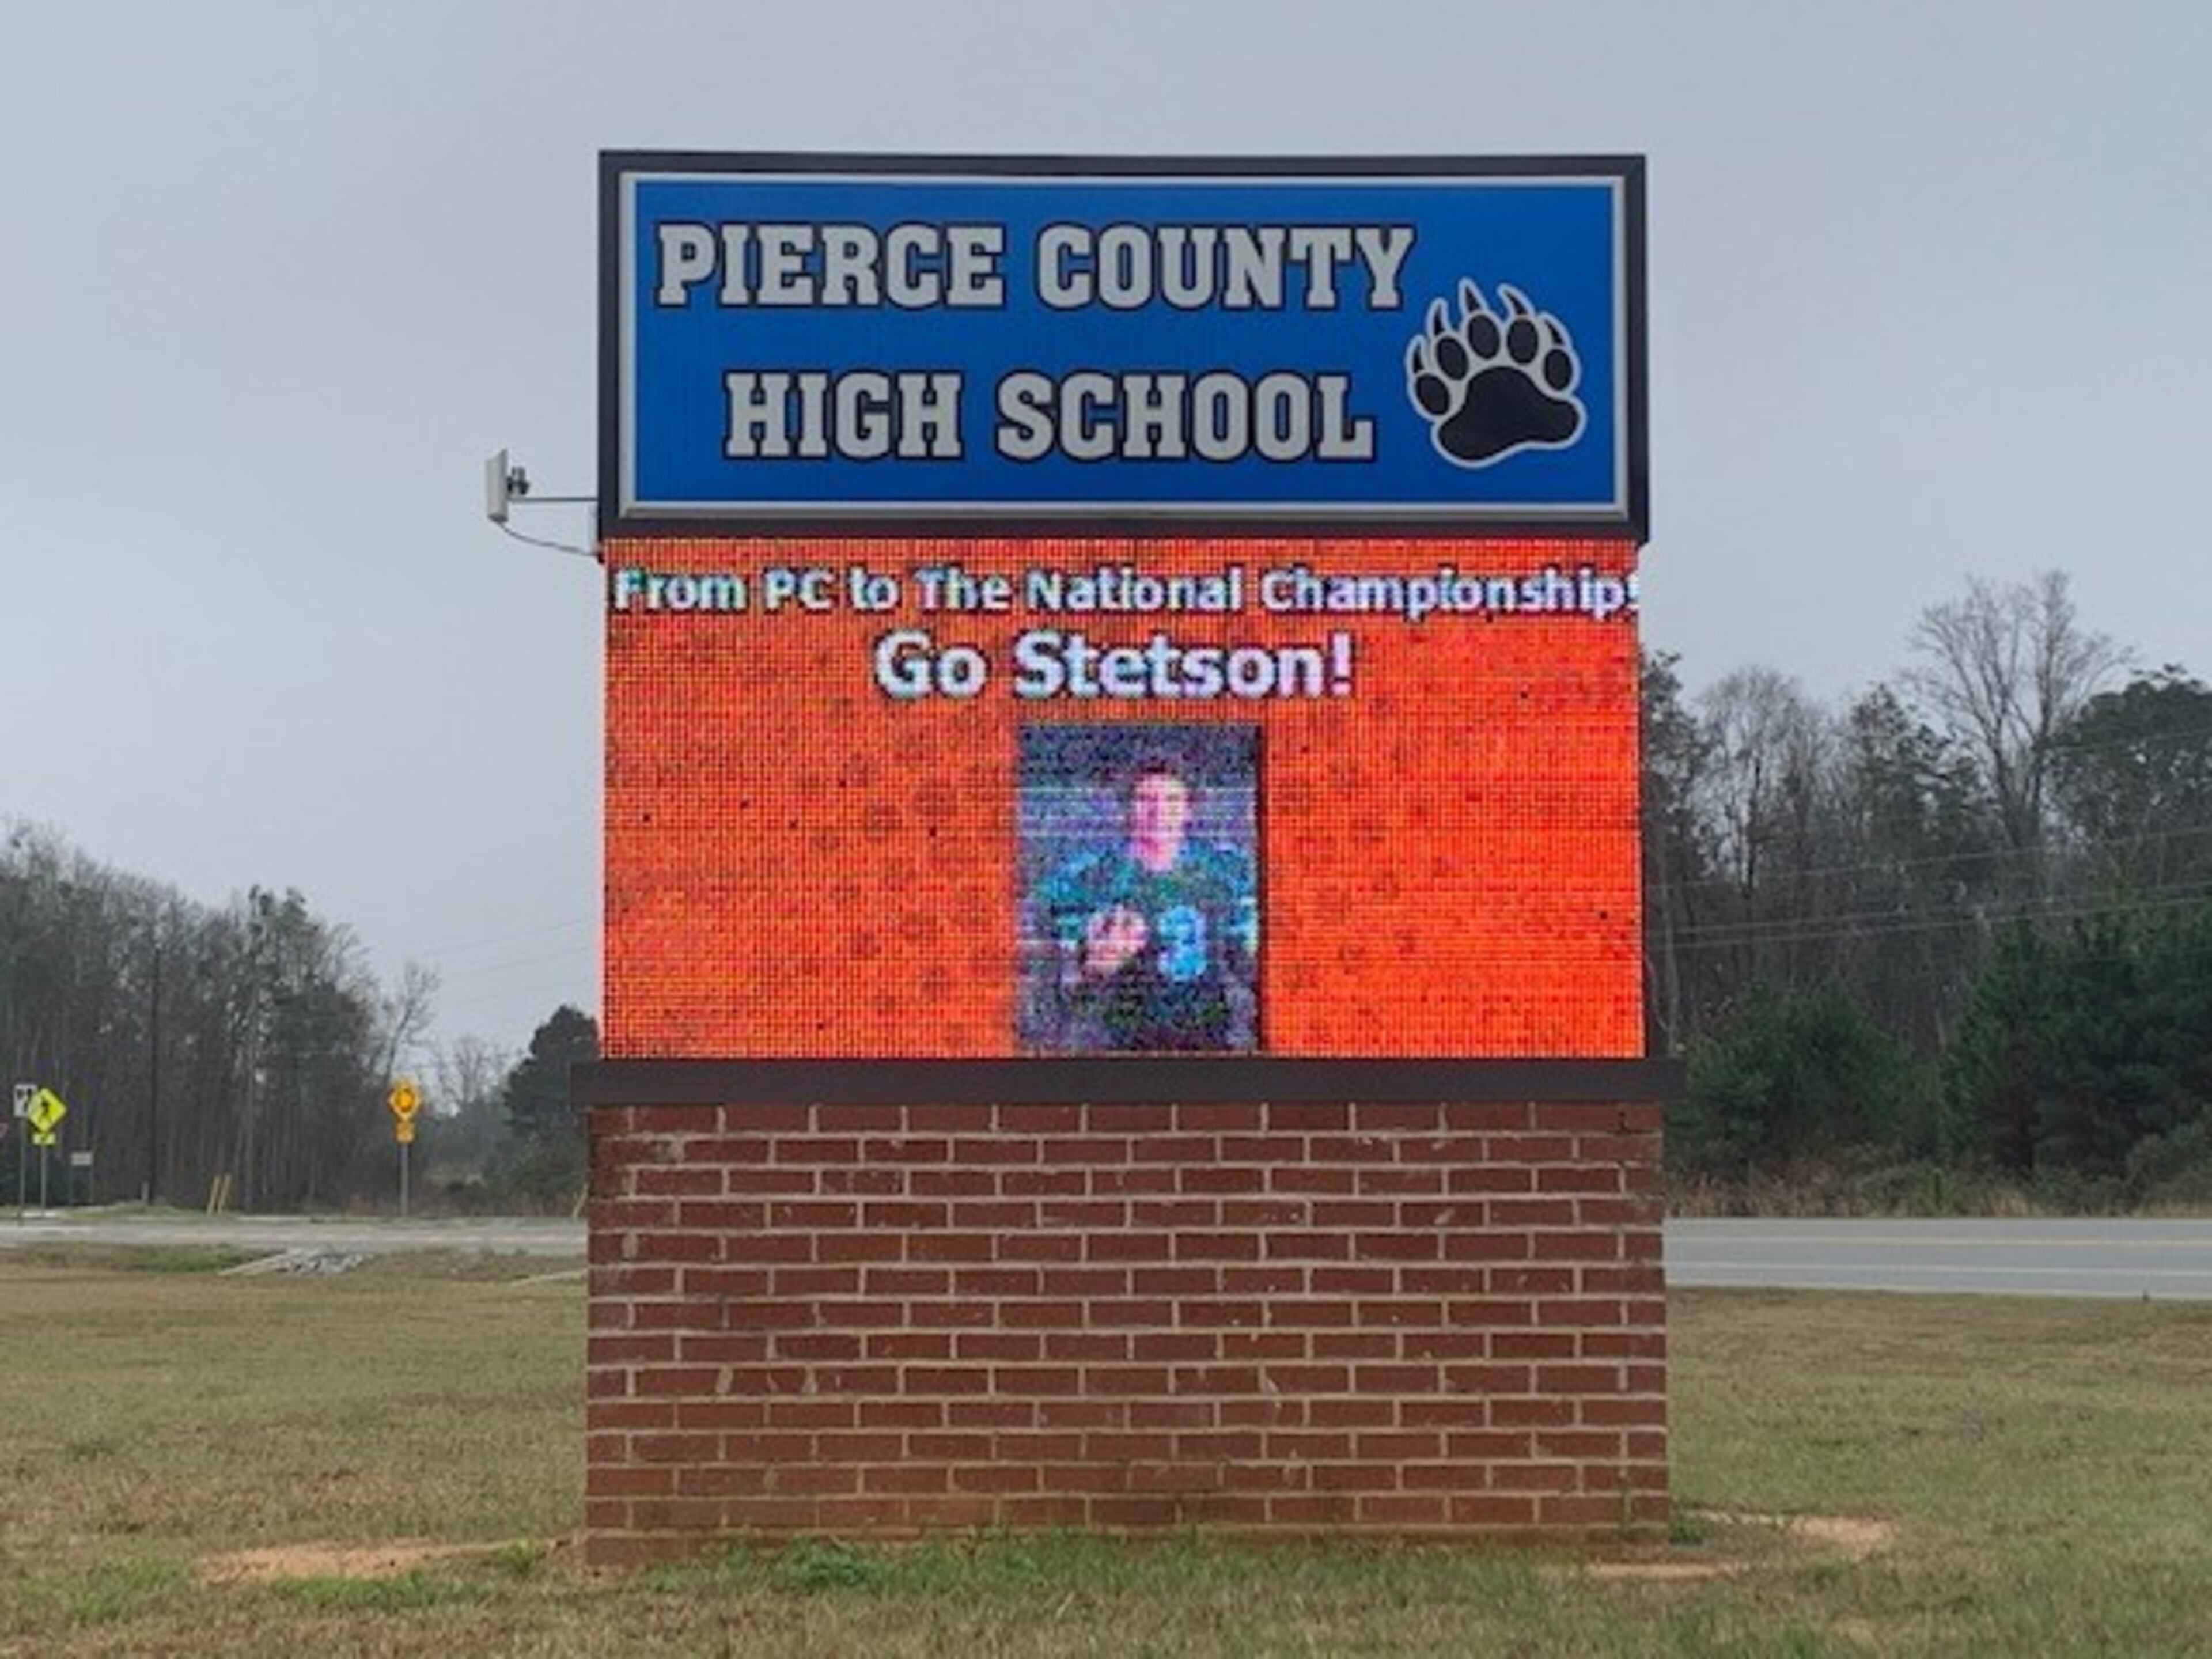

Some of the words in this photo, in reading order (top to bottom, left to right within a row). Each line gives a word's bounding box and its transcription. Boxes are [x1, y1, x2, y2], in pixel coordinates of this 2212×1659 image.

[656, 224, 1006, 309] PIERCE
[1037, 225, 1416, 310] COUNTY
[723, 371, 965, 461] HIGH
[997, 372, 1376, 464] SCHOOL
[615, 567, 747, 611] From
[765, 568, 834, 611] PC
[849, 566, 900, 611] to
[916, 568, 1012, 611] The
[1027, 567, 1242, 611] National
[876, 631, 986, 698] Go
[1014, 630, 1353, 698] Stetson!
